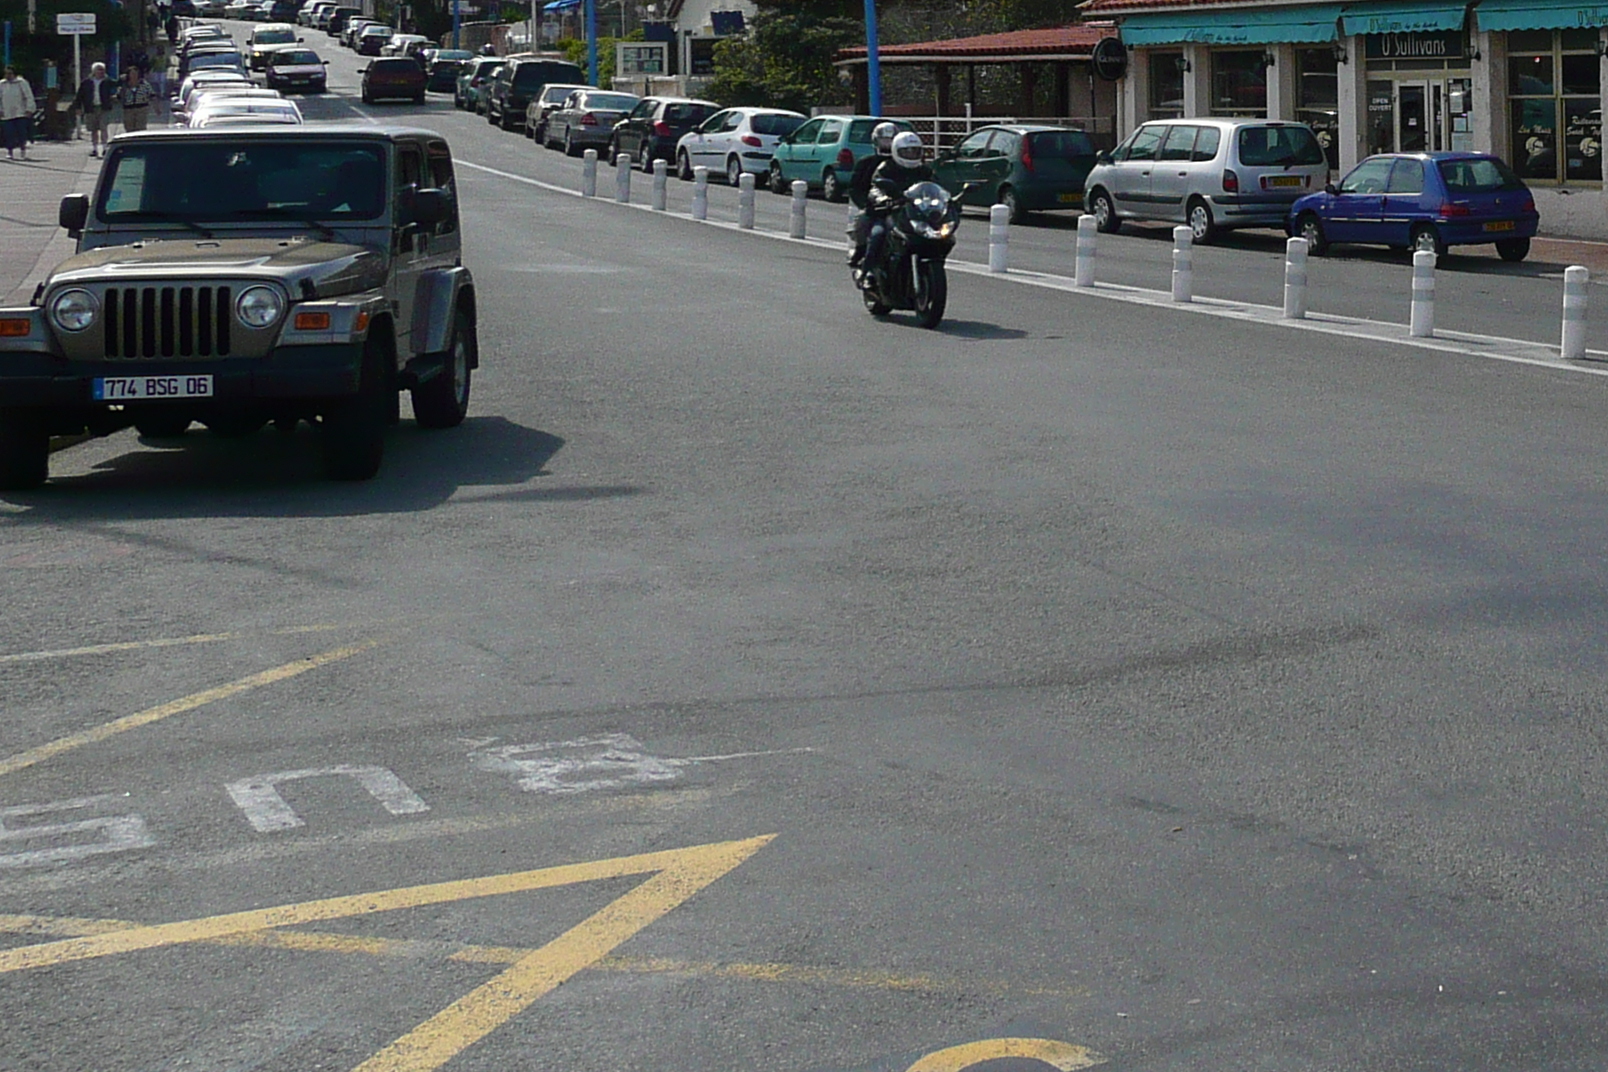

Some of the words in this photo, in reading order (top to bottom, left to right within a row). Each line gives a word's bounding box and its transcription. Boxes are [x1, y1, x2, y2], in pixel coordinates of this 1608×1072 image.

[1381, 33, 1446, 56] O'Sullivans
[105, 379, 137, 396] 774
[146, 378, 178, 396] BSG
[187, 377, 208, 395] 06
